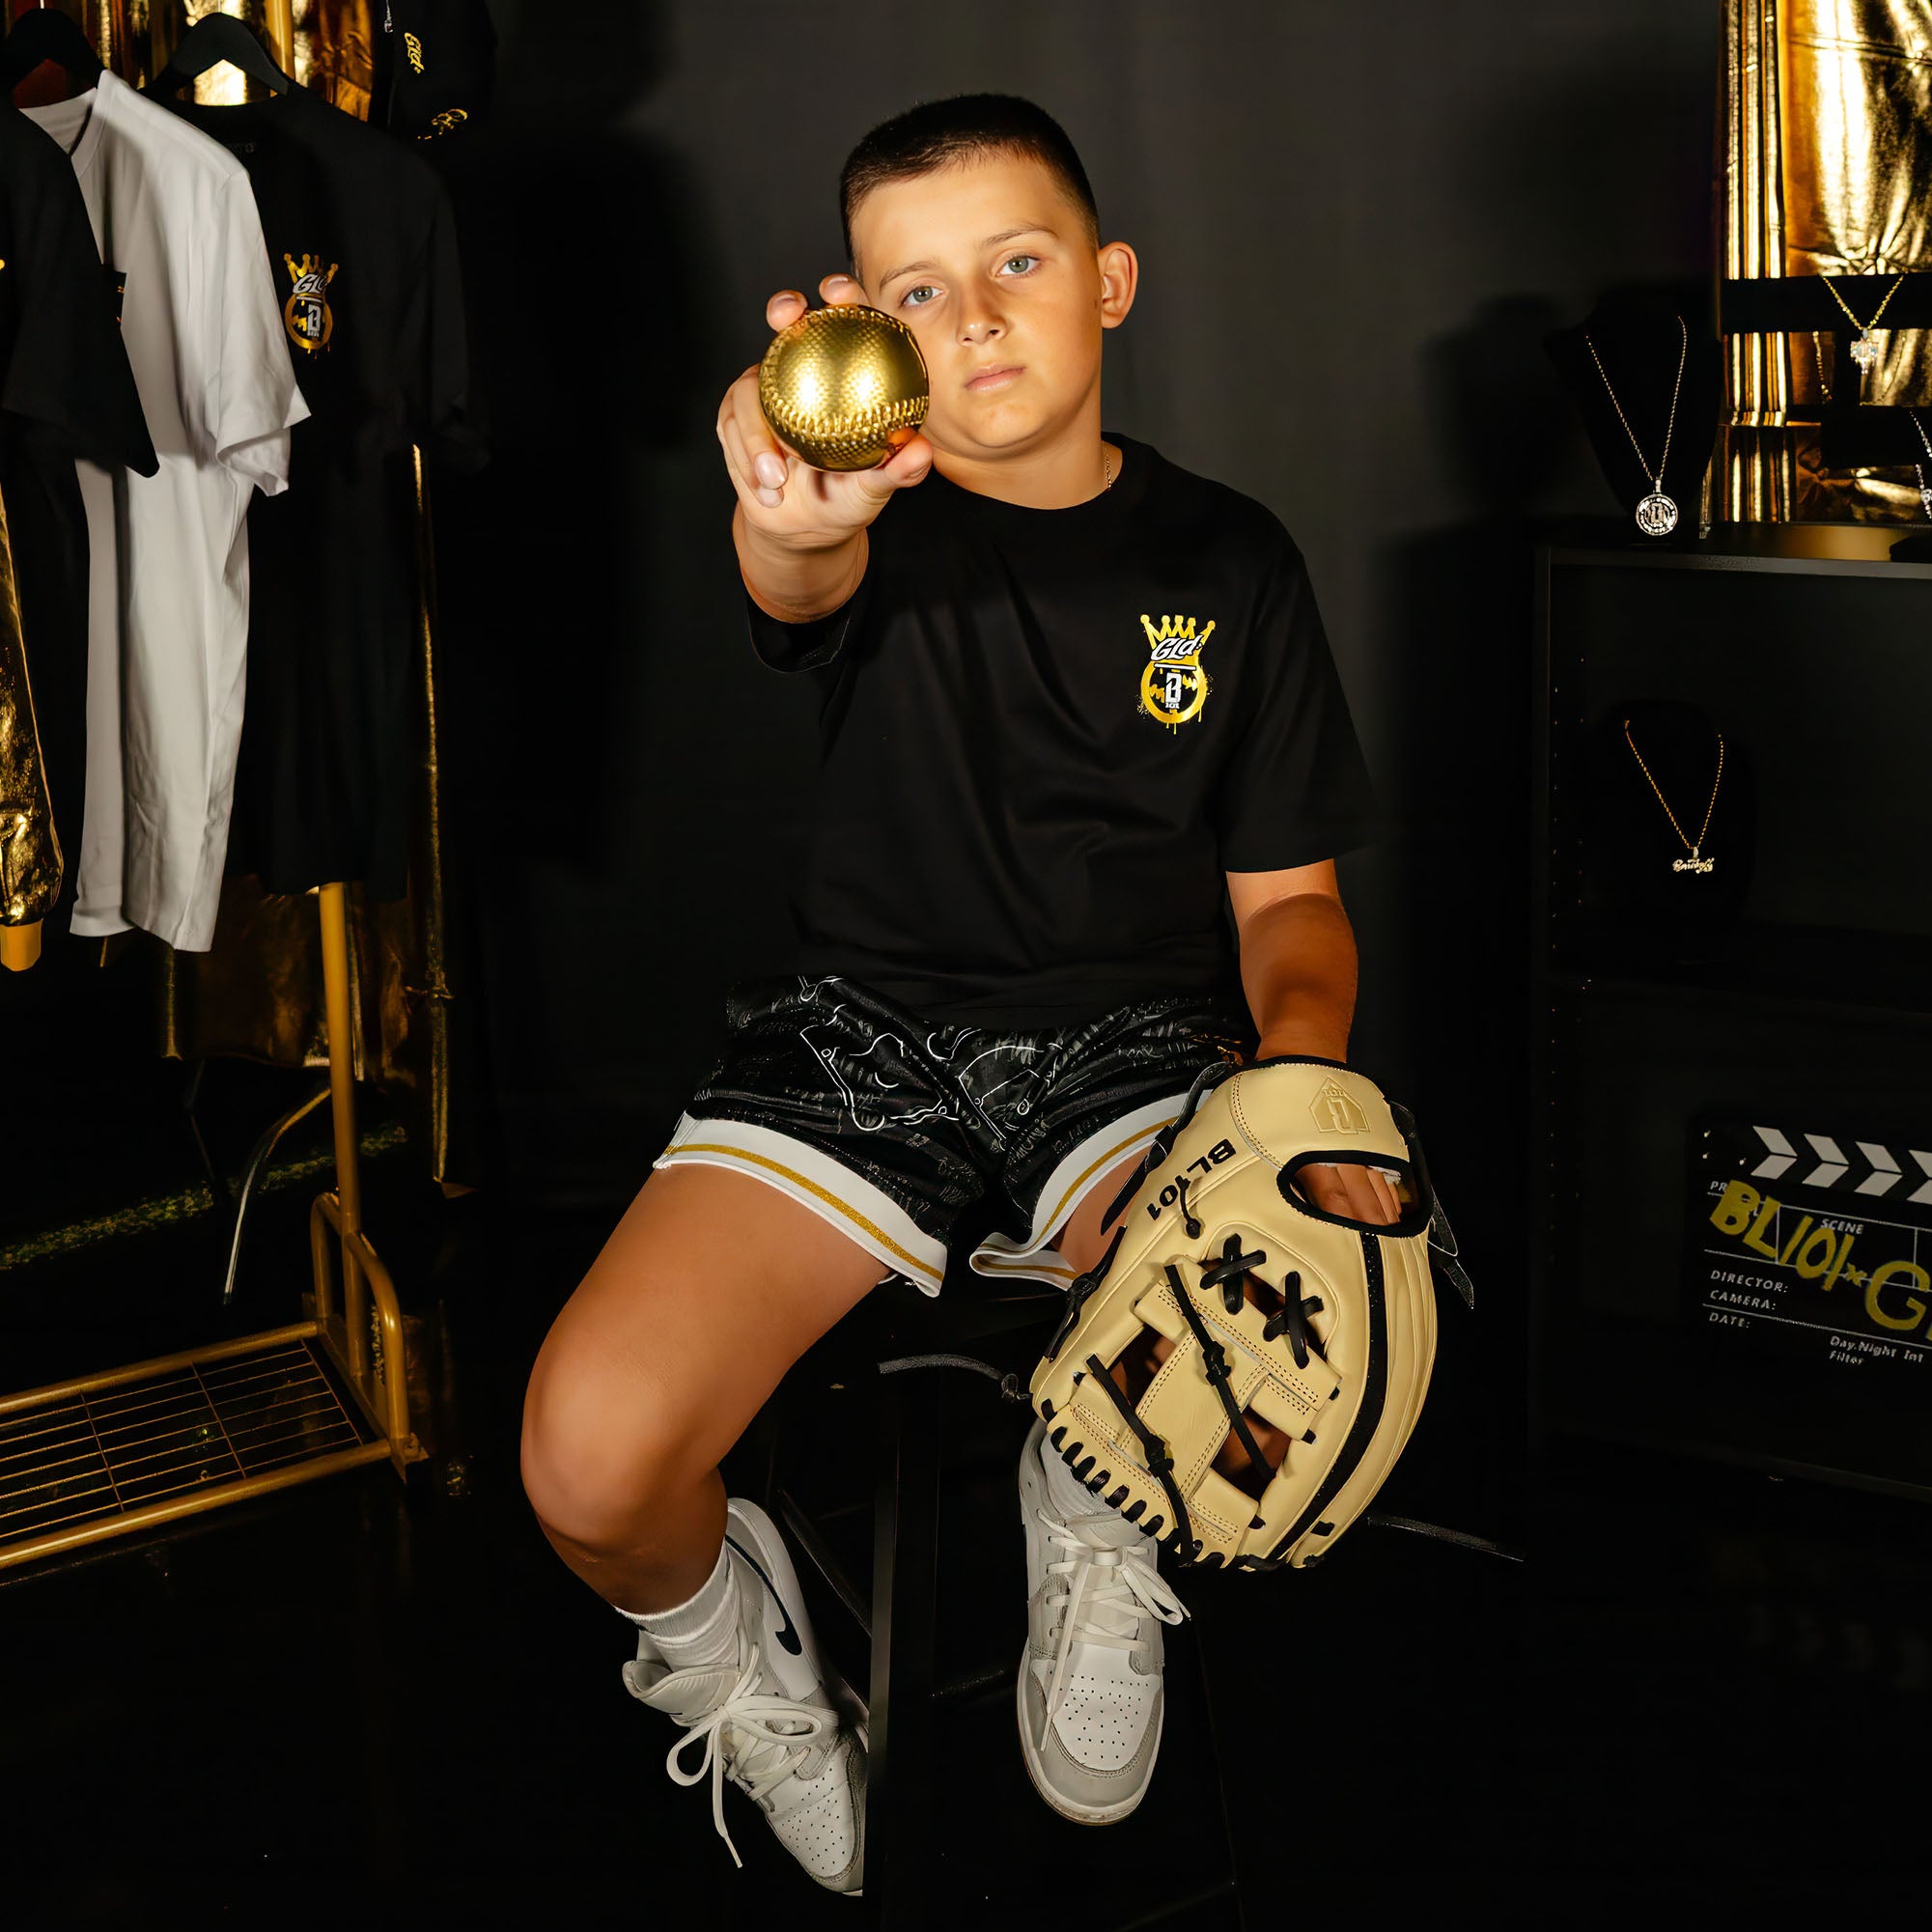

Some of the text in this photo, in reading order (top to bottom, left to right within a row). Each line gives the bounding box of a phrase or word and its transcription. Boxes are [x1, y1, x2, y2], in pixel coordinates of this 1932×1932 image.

[1820, 1218, 1864, 1235] SCENE
[1710, 1269, 1789, 1294] DIRECTOR:
[1709, 1289, 1777, 1311] CAMERA:
[1708, 1311, 1751, 1329] DATE:
